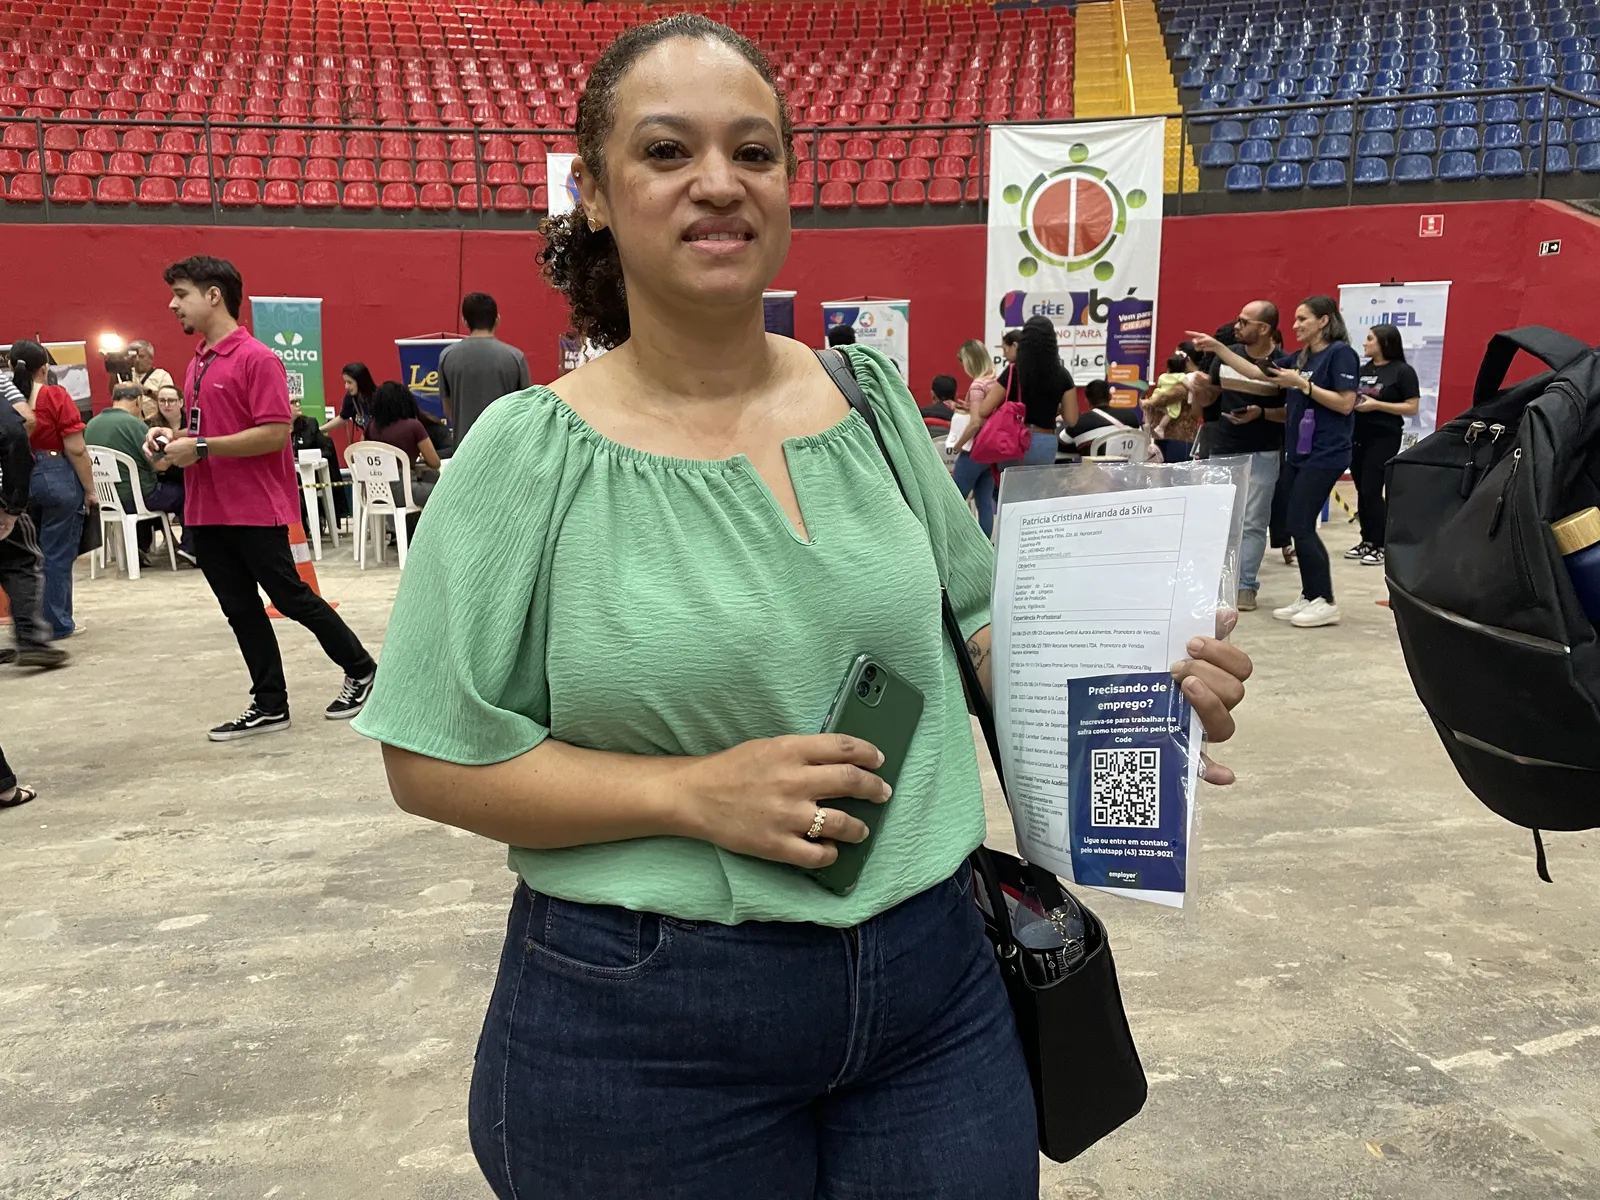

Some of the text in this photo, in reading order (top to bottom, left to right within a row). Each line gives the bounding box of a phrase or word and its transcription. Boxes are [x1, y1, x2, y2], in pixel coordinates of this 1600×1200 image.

[1075, 330, 1101, 341] PARA
[1071, 355, 1088, 367] de
[409, 365, 439, 387] Le
[1122, 440, 1133, 450] 10
[94, 456, 101, 466] 4
[367, 456, 381, 466] 05
[1052, 513, 1082, 523] Cristina
[1084, 508, 1117, 520] Miranda
[1119, 507, 1130, 516] da
[1132, 505, 1152, 515] Silva
[1018, 562, 1036, 570] Objetivo
[1088, 682, 1167, 696] Precisando de
[1098, 699, 1153, 711] emprego?
[1080, 718, 1113, 726] Inscreva-se
[1115, 717, 1130, 725] para
[1131, 715, 1165, 723] trabalhar
[1077, 728, 1092, 736] safra
[1111, 726, 1149, 736] temporário
[1150, 726, 1167, 734] pelo
[1168, 726, 1180, 734] QR
[1115, 736, 1133, 744] Code
[1084, 837, 1099, 846] Ligue
[1140, 839, 1169, 847] contato
[1080, 847, 1174, 858] pelo whatsapp (43) 3323-9021
[1109, 871, 1136, 880] employer
